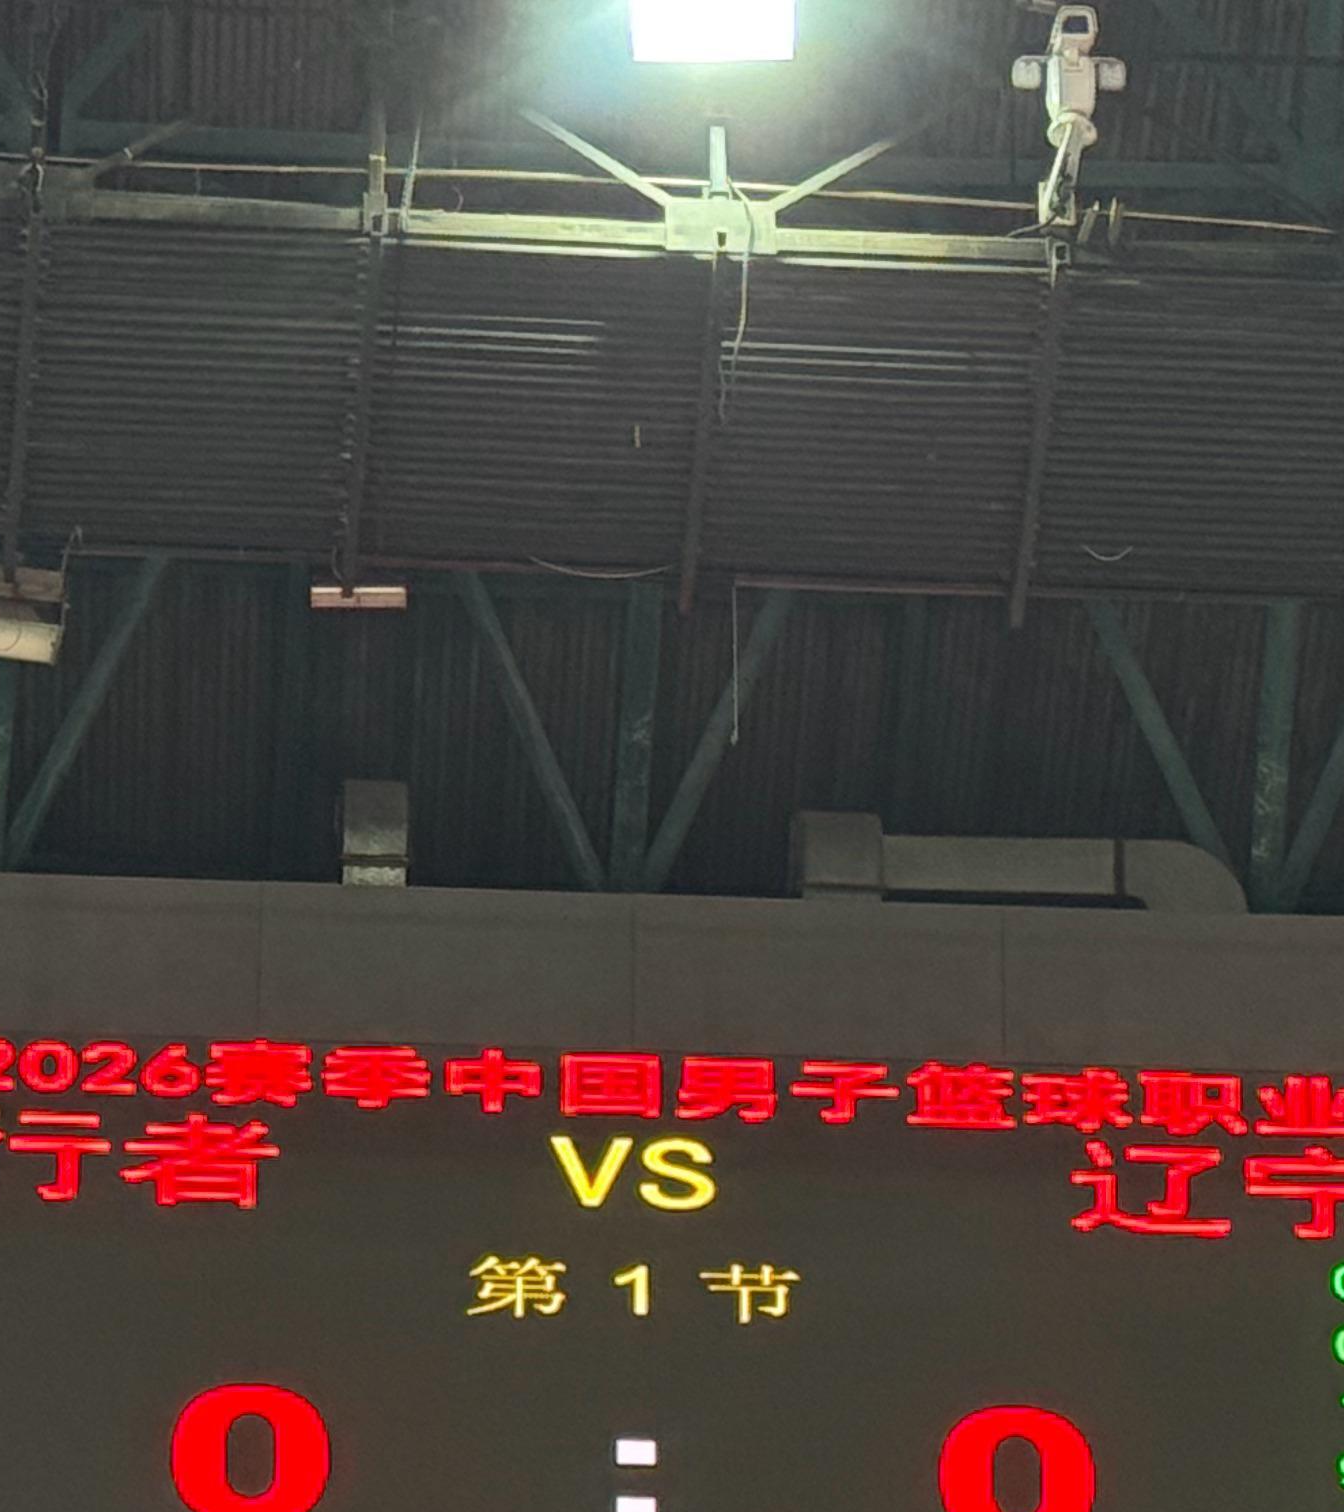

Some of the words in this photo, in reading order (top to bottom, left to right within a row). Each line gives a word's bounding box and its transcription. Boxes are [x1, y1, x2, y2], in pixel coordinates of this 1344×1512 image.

[551, 1136, 717, 1210] VS
[476, 1255, 565, 1315] 第
[617, 1267, 649, 1313] 1
[703, 1265, 795, 1321] 节
